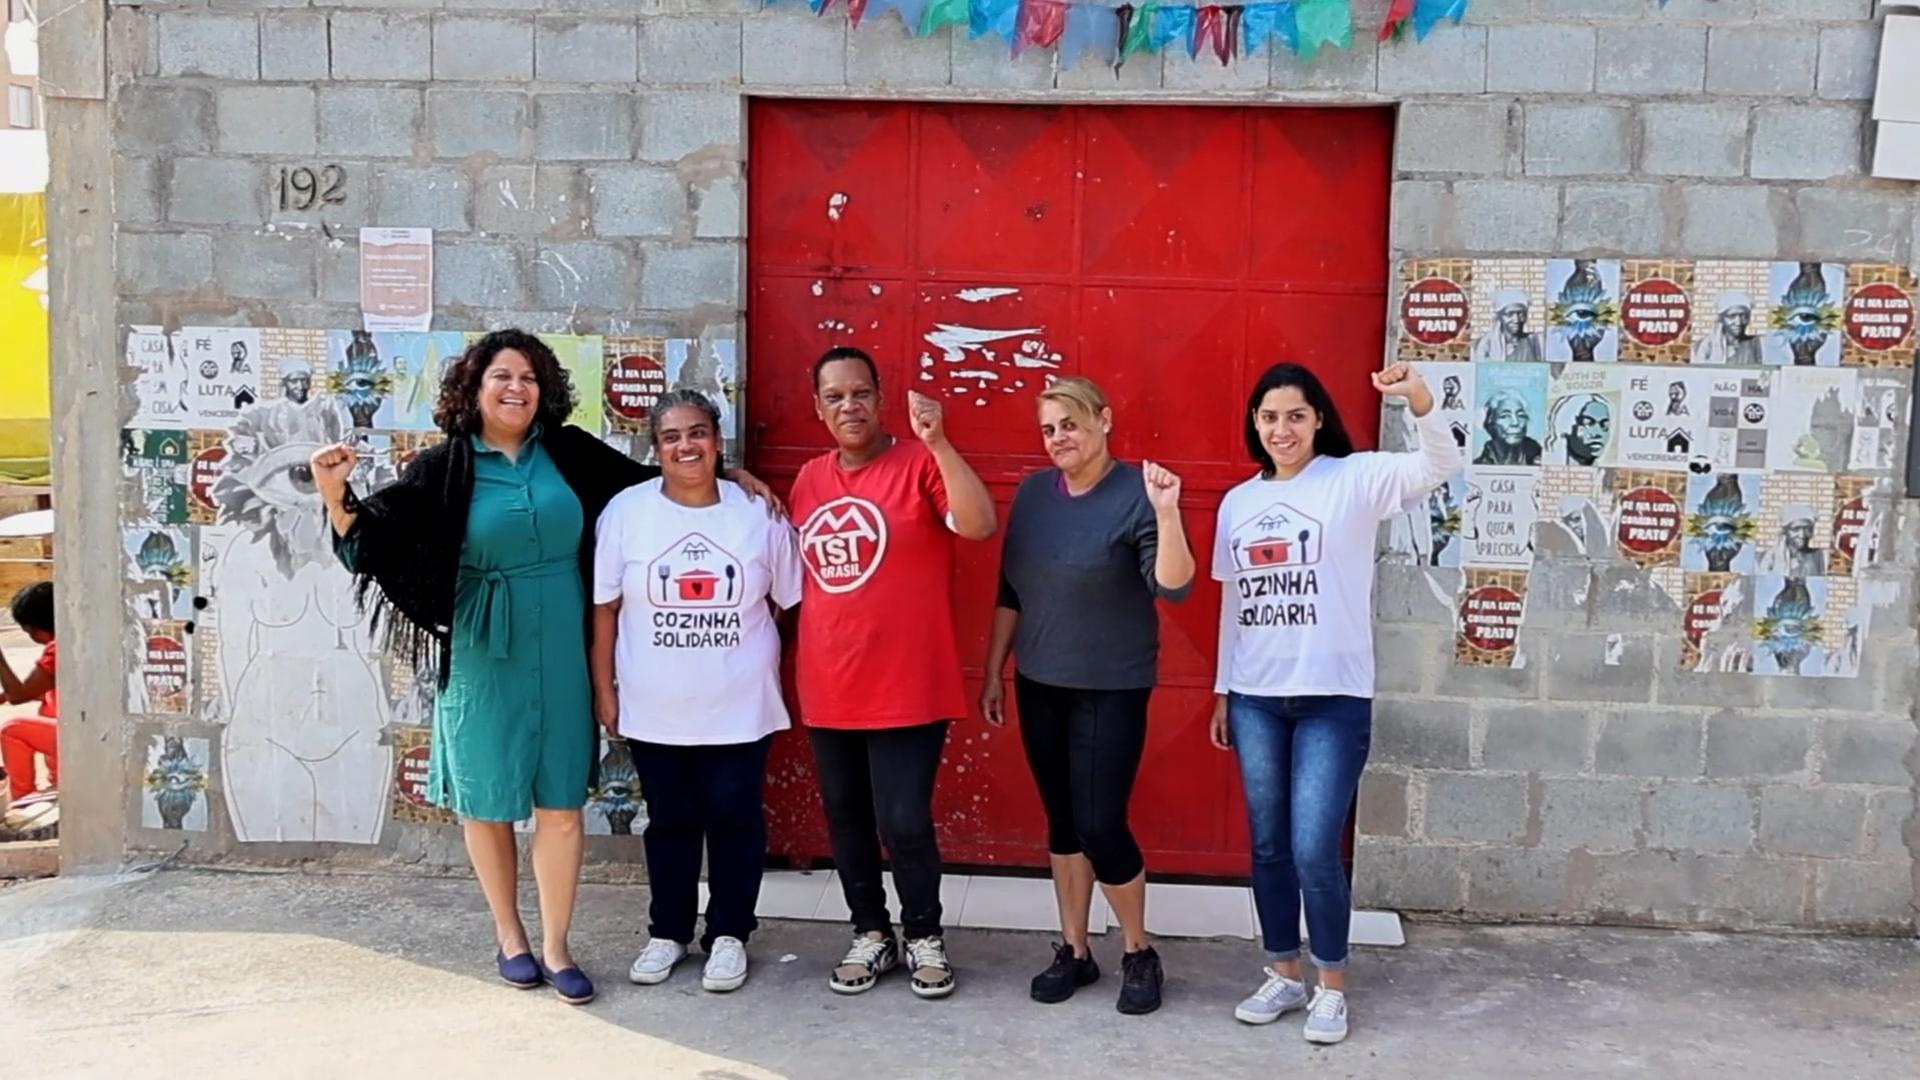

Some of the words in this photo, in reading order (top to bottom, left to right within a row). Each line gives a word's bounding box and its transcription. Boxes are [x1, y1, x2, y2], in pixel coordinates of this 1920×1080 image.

[275, 164, 346, 212] 192
[1423, 293, 1438, 302] NA
[1440, 293, 1464, 302] LUTA
[1643, 293, 1659, 303] NA
[1661, 293, 1686, 304] LUTA
[1867, 298, 1883, 308] NA
[1884, 298, 1909, 309] LUTA
[1408, 307, 1446, 317] COMIDA
[1447, 307, 1463, 317] NO
[1629, 308, 1668, 318] COMIDA
[1668, 308, 1685, 319] NO
[1851, 313, 1890, 323] COMIDA
[1892, 313, 1908, 324] NO
[1417, 319, 1457, 332] PRATO
[1638, 320, 1678, 333] PRATO
[1861, 325, 1901, 338] PRATO
[625, 369, 640, 378] NA
[641, 369, 664, 379] LUTA
[612, 383, 648, 393] COMIDA
[649, 384, 664, 394] NO
[1630, 375, 1649, 391] FÉ
[1713, 381, 1738, 393] NÃO
[198, 384, 236, 397] LUTA
[621, 394, 658, 407] PRATO
[1628, 426, 1668, 439] LUTA
[1490, 479, 1516, 493] CASA
[1487, 500, 1513, 513] PARA
[1635, 501, 1651, 511] NA
[1653, 502, 1677, 513] LUTA
[1621, 515, 1658, 527] COMIDA
[1660, 517, 1675, 527] NO
[1486, 521, 1516, 538] QUEM
[1629, 527, 1669, 541] PRATO
[1480, 542, 1521, 556] PRECISA
[820, 562, 862, 579] BRASIL
[1238, 569, 1318, 599] OZINHA
[1481, 600, 1497, 610] NA
[1498, 601, 1522, 611] LUTA
[653, 611, 741, 629] COZINHA
[1467, 614, 1505, 625] COMIDA
[653, 629, 740, 648] SOLIDÁRIA
[1476, 626, 1515, 639] PRATO
[164, 650, 186, 660] LUTA
